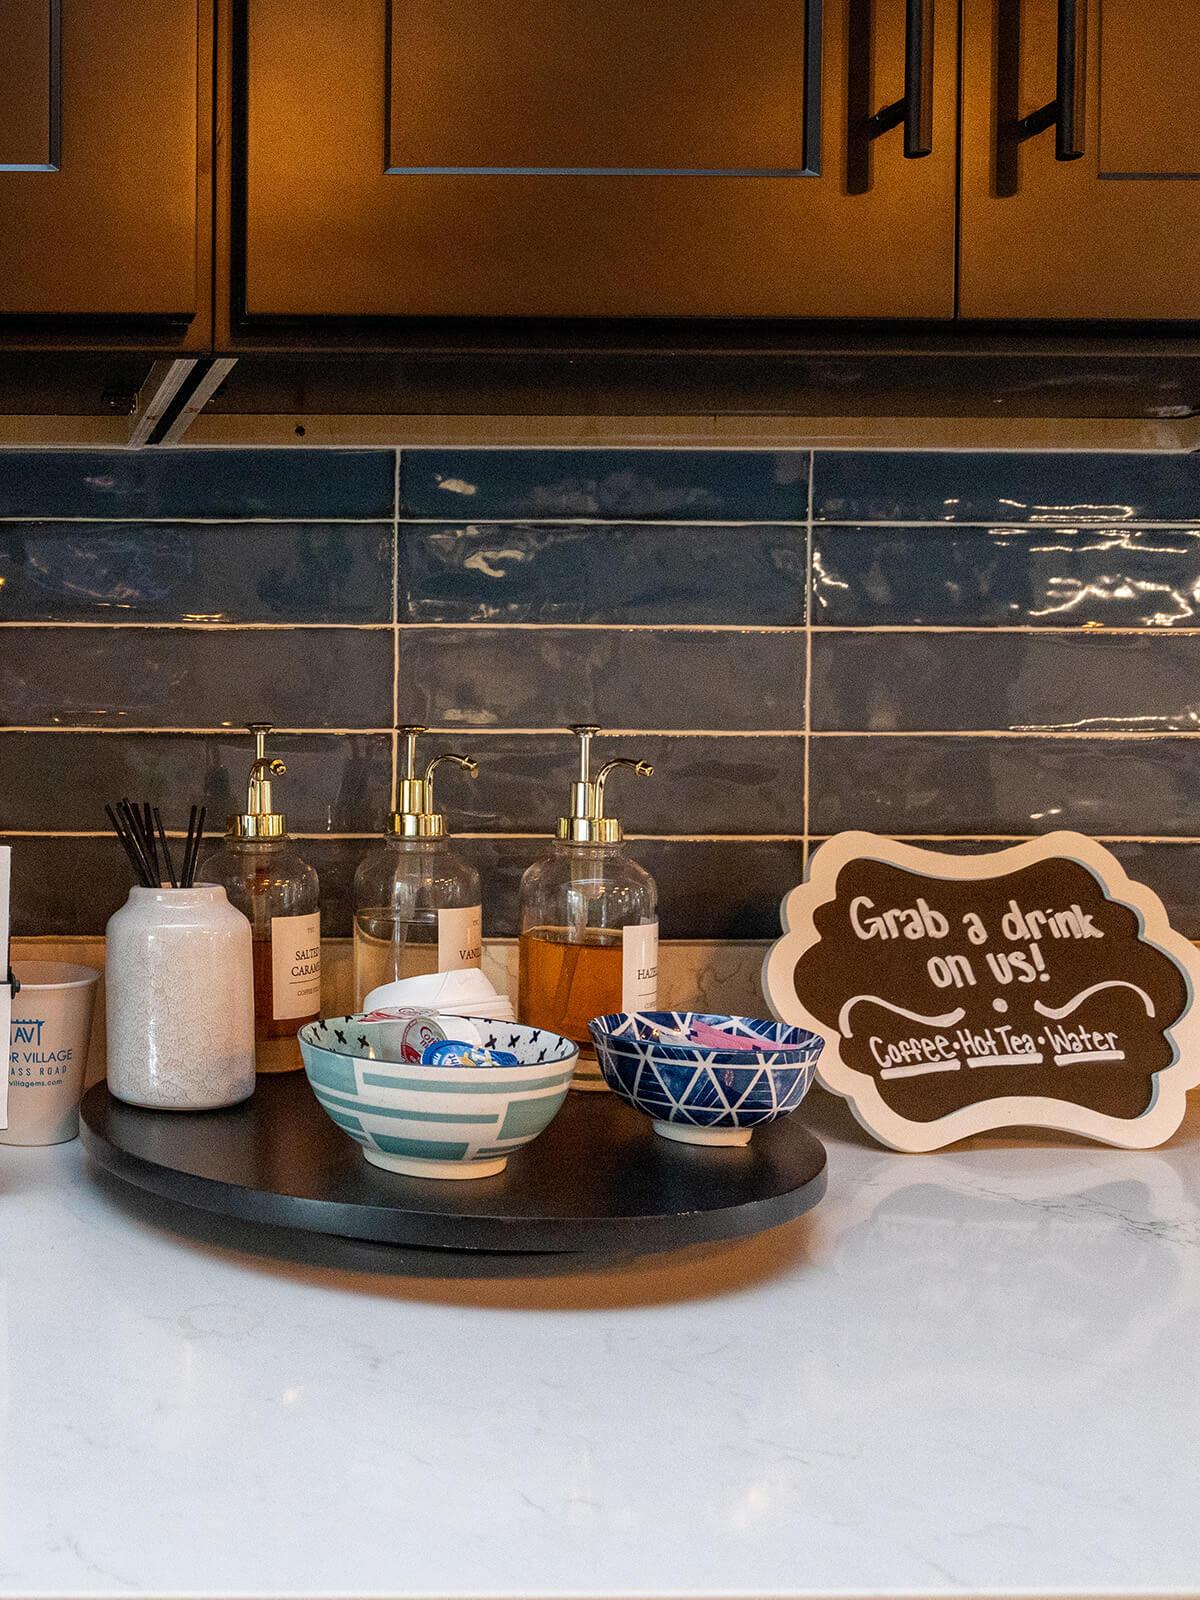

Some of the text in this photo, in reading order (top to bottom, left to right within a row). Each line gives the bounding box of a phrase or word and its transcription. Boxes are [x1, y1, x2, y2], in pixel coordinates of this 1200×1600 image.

[849, 896, 1105, 945] Grab a drink
[926, 942, 1051, 988] on us!
[1044, 1025, 1119, 1055] Water
[22, 1049, 73, 1063] VILLAGE
[39, 1065, 67, 1076] ROAD
